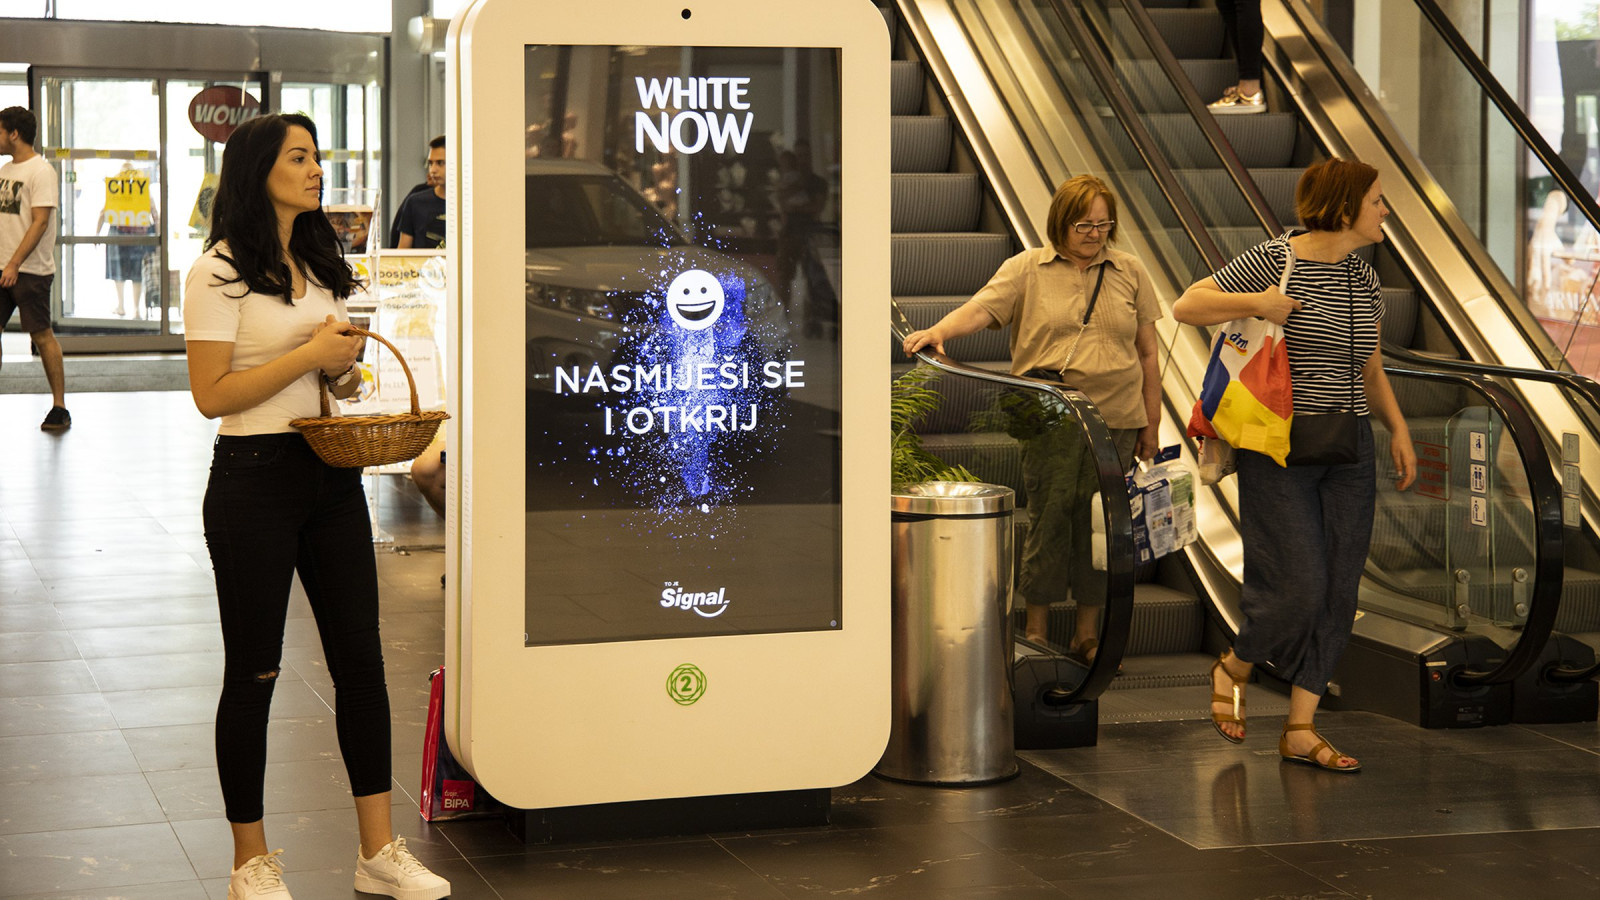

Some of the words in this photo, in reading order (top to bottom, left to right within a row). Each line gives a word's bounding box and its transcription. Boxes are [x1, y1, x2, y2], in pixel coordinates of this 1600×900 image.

[635, 76, 751, 109] WHITE
[635, 111, 755, 154] NOW
[108, 179, 147, 195] CITY
[105, 210, 150, 227] one
[1229, 331, 1249, 349] dm
[555, 355, 749, 394] NASMIJEŠI
[763, 361, 805, 388] SE
[605, 407, 612, 435] I
[627, 403, 757, 434] OTKRIJ
[660, 587, 726, 610] Signal
[680, 676, 692, 692] 2
[444, 799, 470, 809] BIPA
